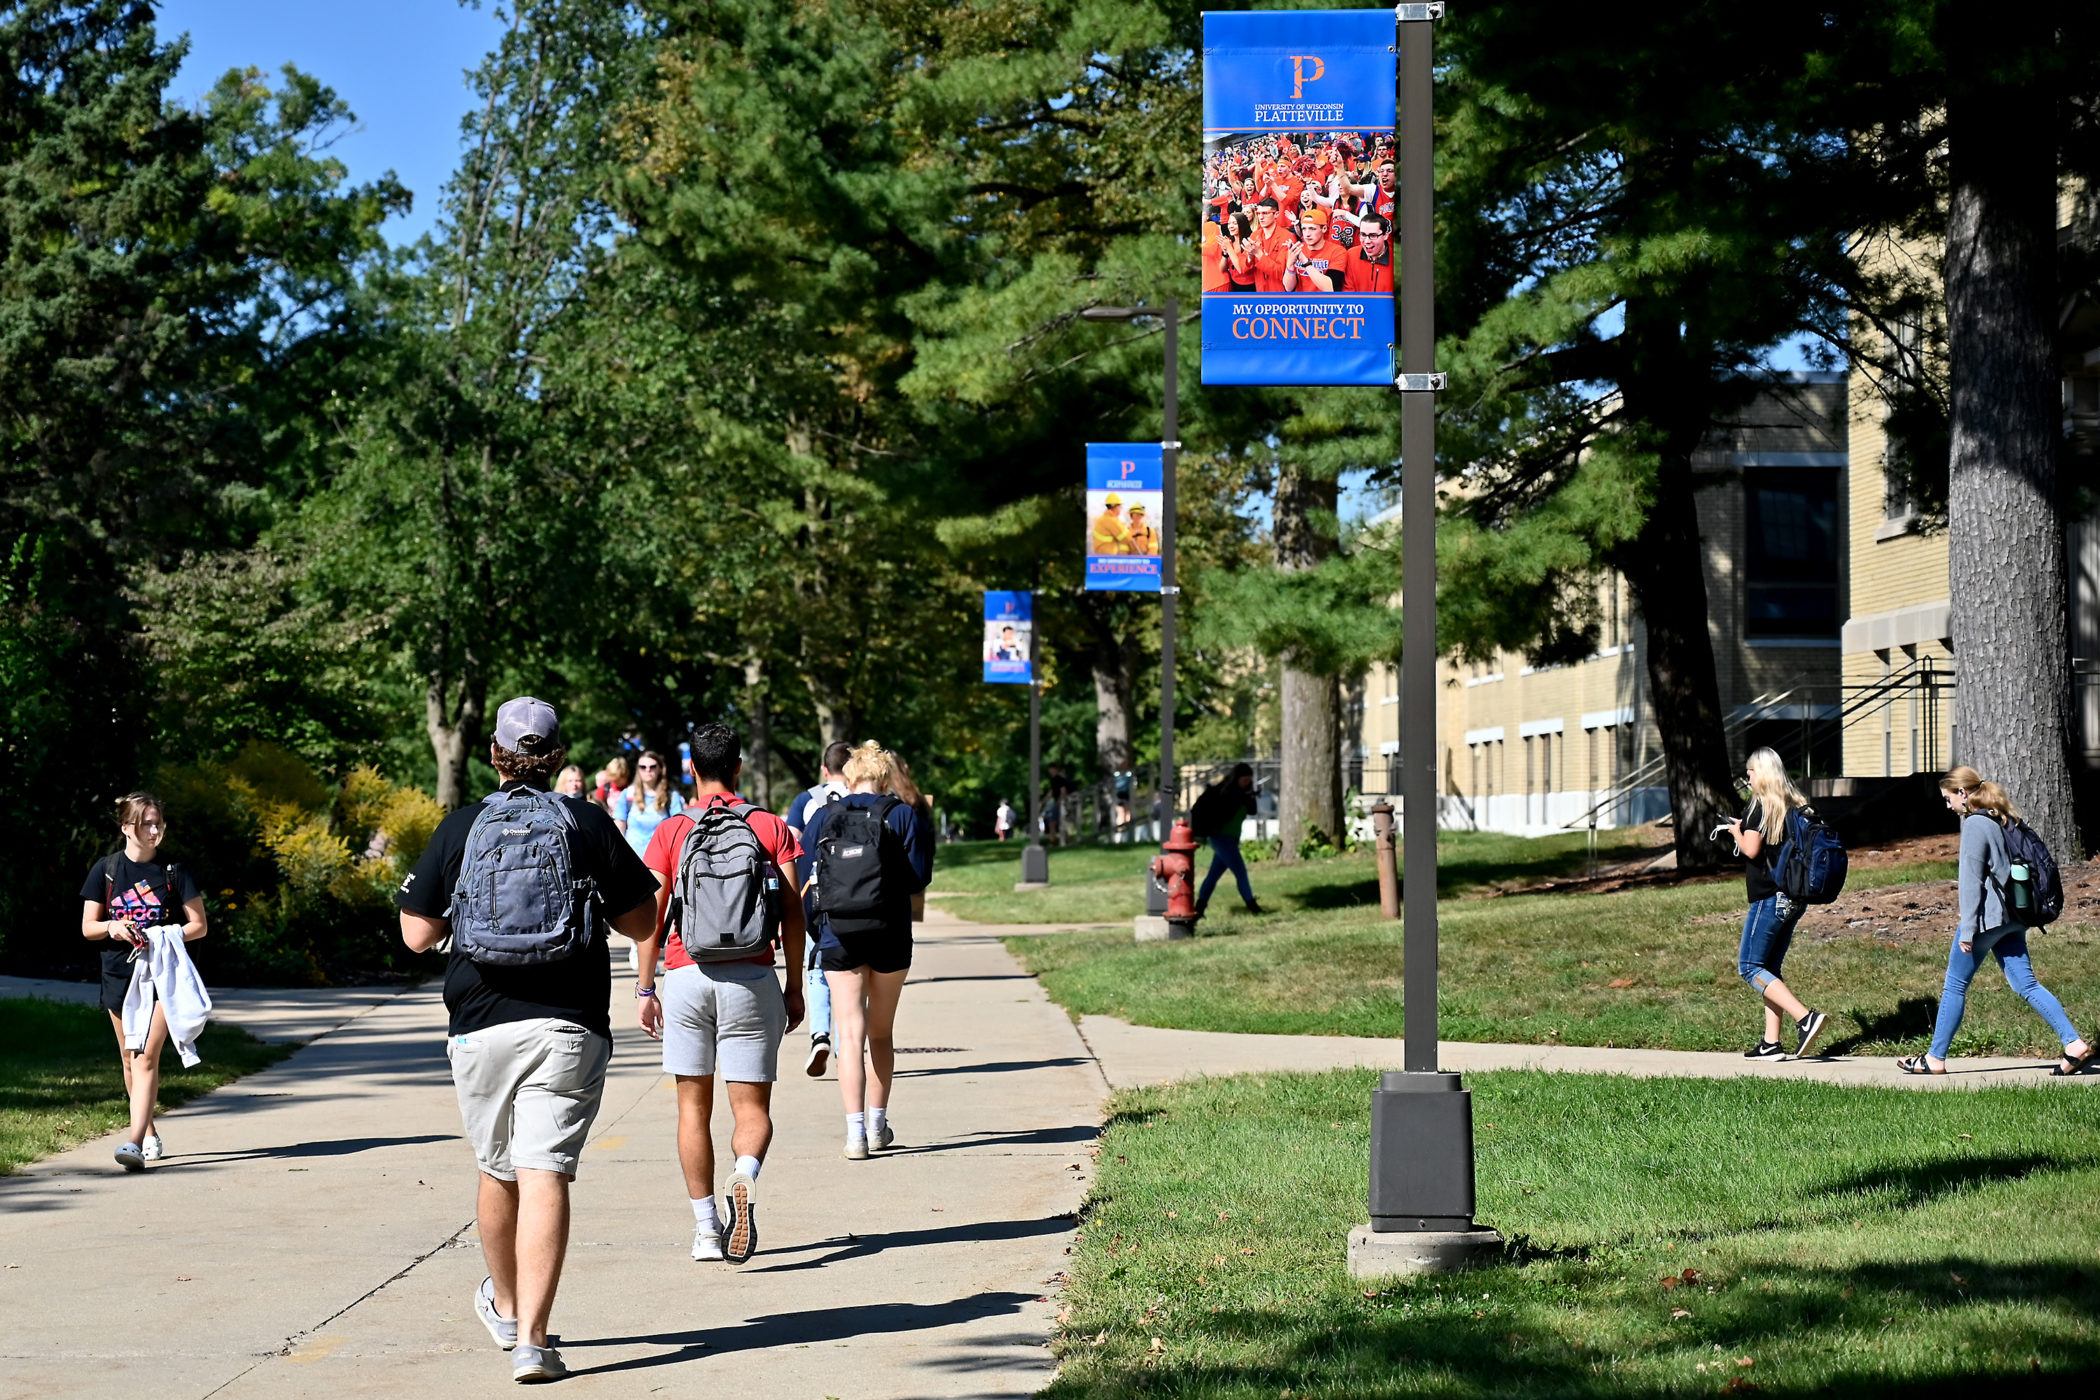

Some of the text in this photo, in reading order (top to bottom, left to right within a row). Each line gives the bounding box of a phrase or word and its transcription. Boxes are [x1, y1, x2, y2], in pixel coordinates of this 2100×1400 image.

[1289, 55, 1325, 98] P
[1254, 103, 1295, 111] UNIVERSITY
[1254, 110, 1344, 122] PLATTEVILLE
[1232, 304, 1365, 315] MY OPPORTUNITY TO
[1232, 317, 1365, 339] CONNECT
[1121, 461, 1136, 480] P
[1090, 563, 1158, 574] EXPERIENCE
